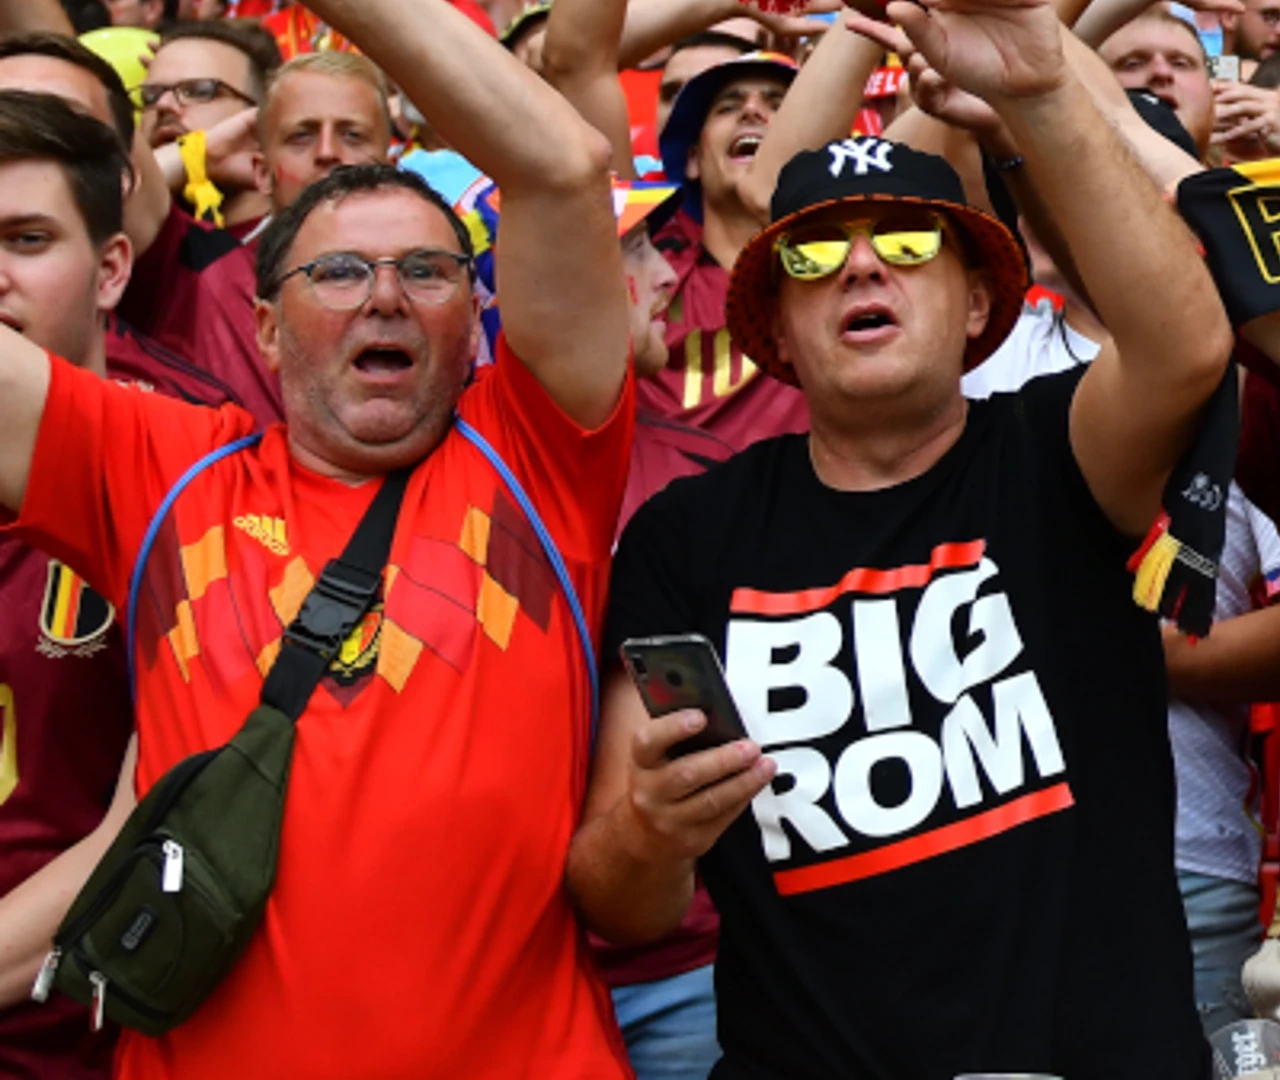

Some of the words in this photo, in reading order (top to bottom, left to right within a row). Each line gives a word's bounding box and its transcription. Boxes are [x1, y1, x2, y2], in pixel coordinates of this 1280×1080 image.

[827, 136, 895, 178] NY
[724, 555, 1025, 747] BIG
[751, 670, 1067, 863] ROM
